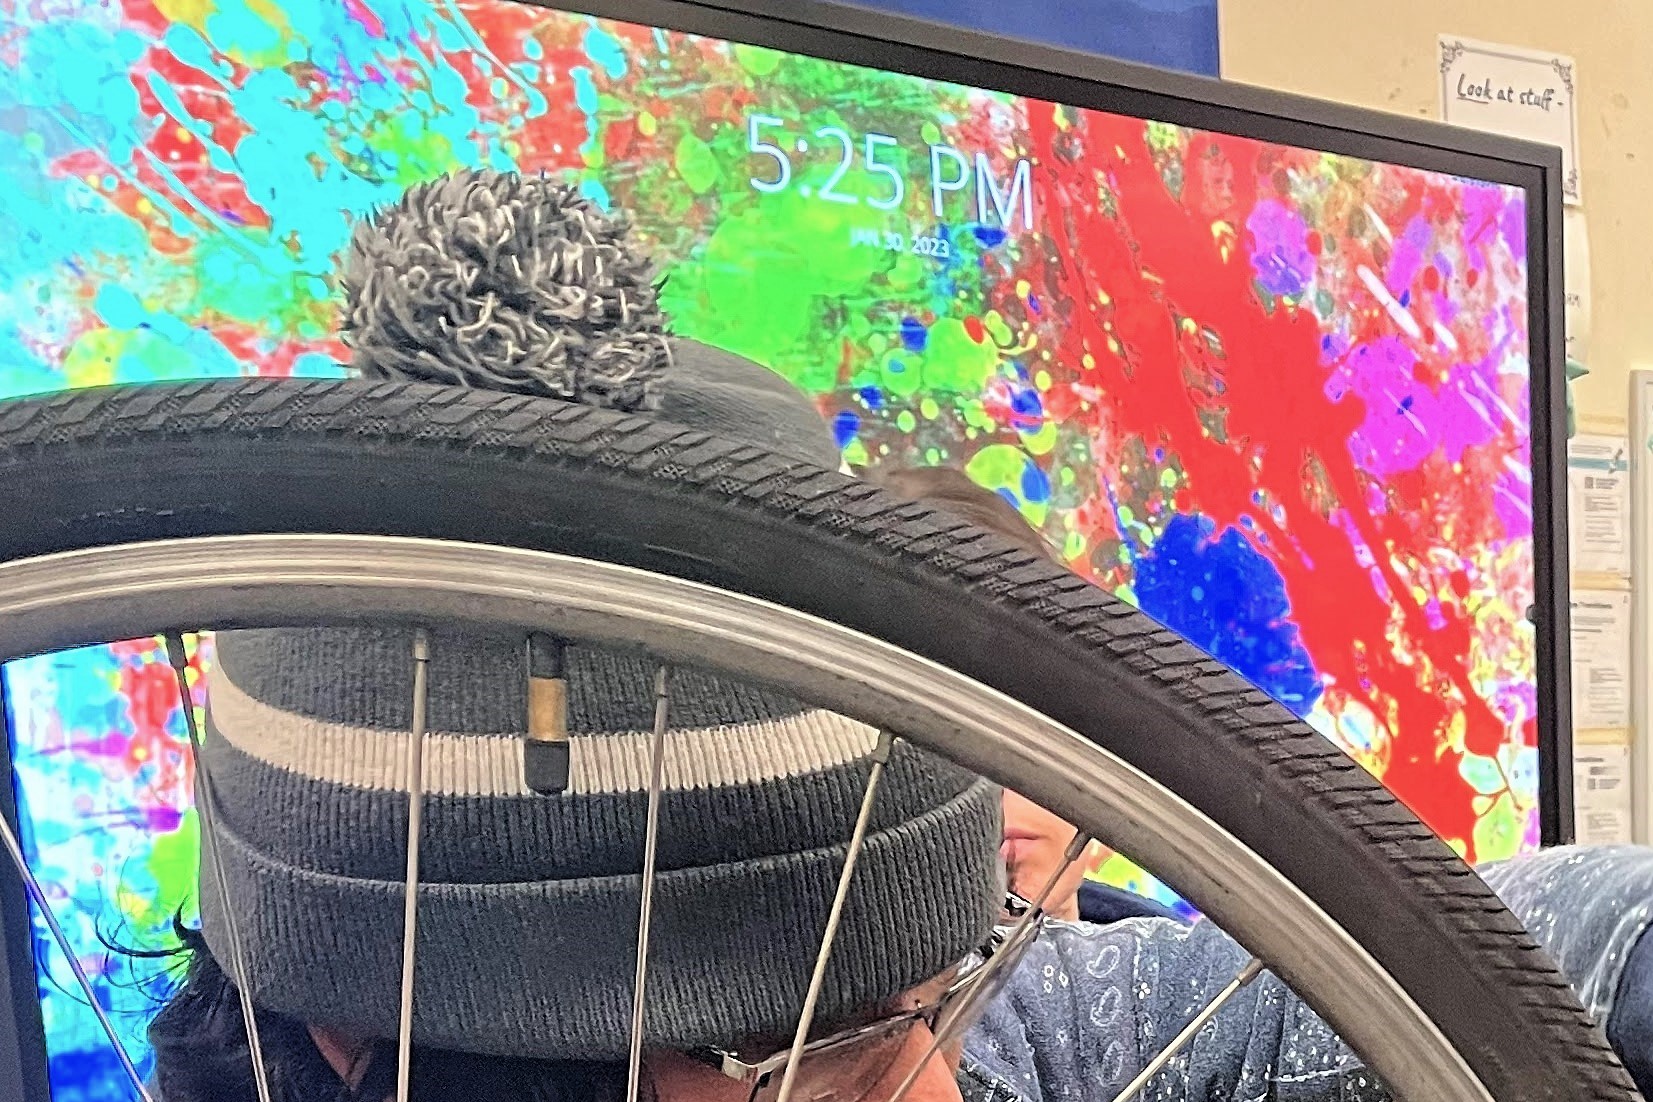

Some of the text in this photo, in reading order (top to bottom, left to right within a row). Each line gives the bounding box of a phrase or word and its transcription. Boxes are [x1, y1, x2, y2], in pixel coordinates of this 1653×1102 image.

[1456, 73, 1494, 101] Look
[1496, 86, 1514, 103] at
[747, 113, 1034, 230] 5:25 PM
